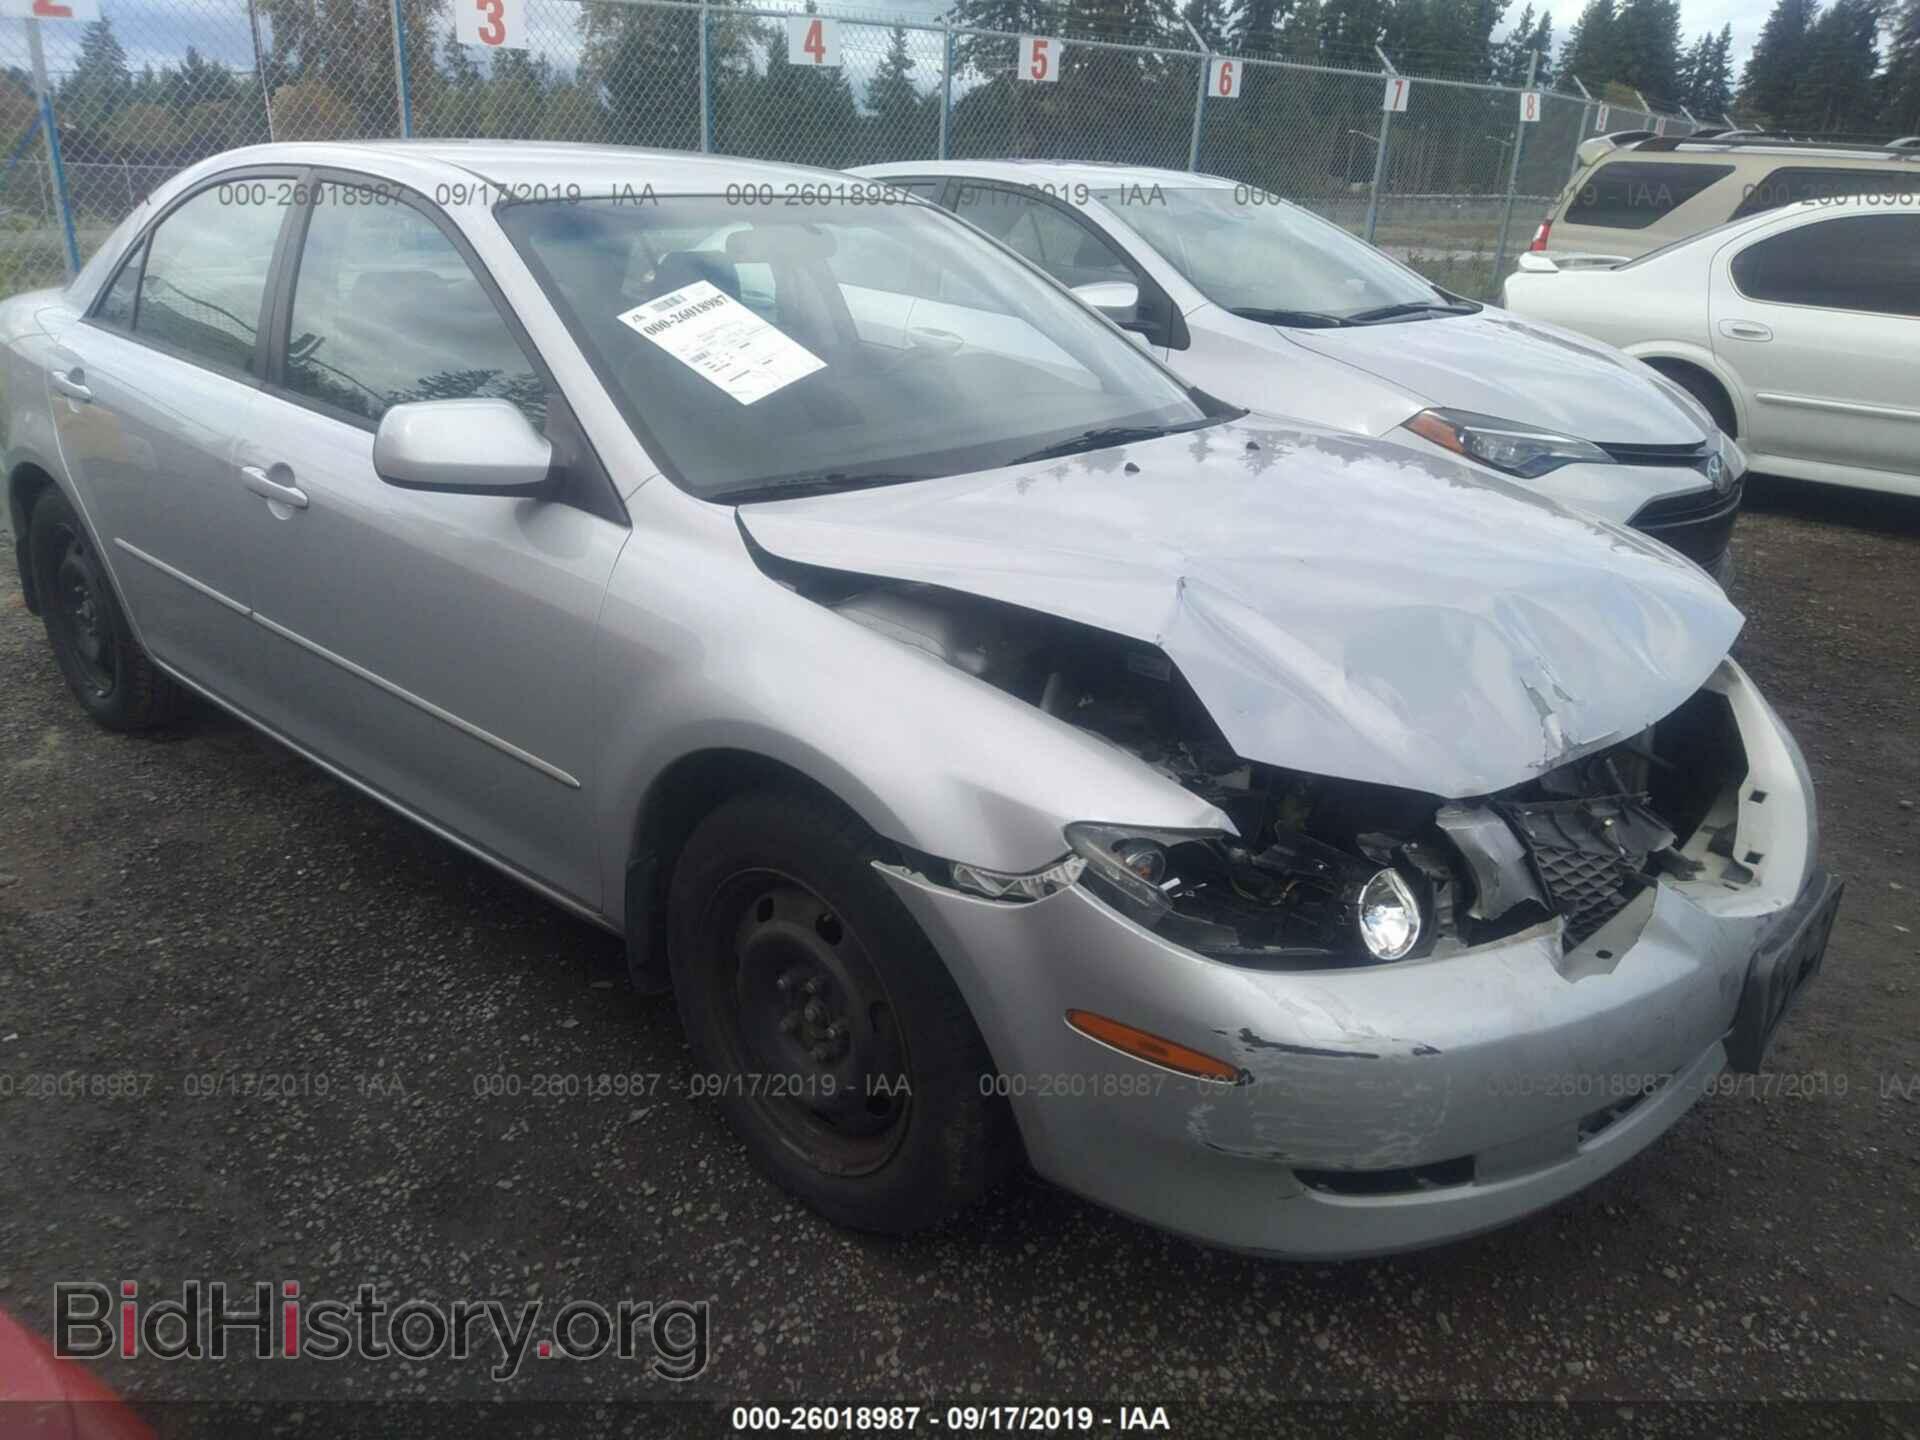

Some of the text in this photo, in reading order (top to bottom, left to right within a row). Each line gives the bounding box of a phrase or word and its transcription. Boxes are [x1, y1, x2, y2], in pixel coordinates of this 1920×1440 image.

[476, 0, 506, 45] 3
[804, 19, 826, 64] 4
[1032, 39, 1048, 80] 5
[1220, 62, 1233, 96] 6
[1393, 80, 1403, 111] 7
[1527, 95, 1534, 119] 8
[643, 294, 728, 336] 000-26018987
